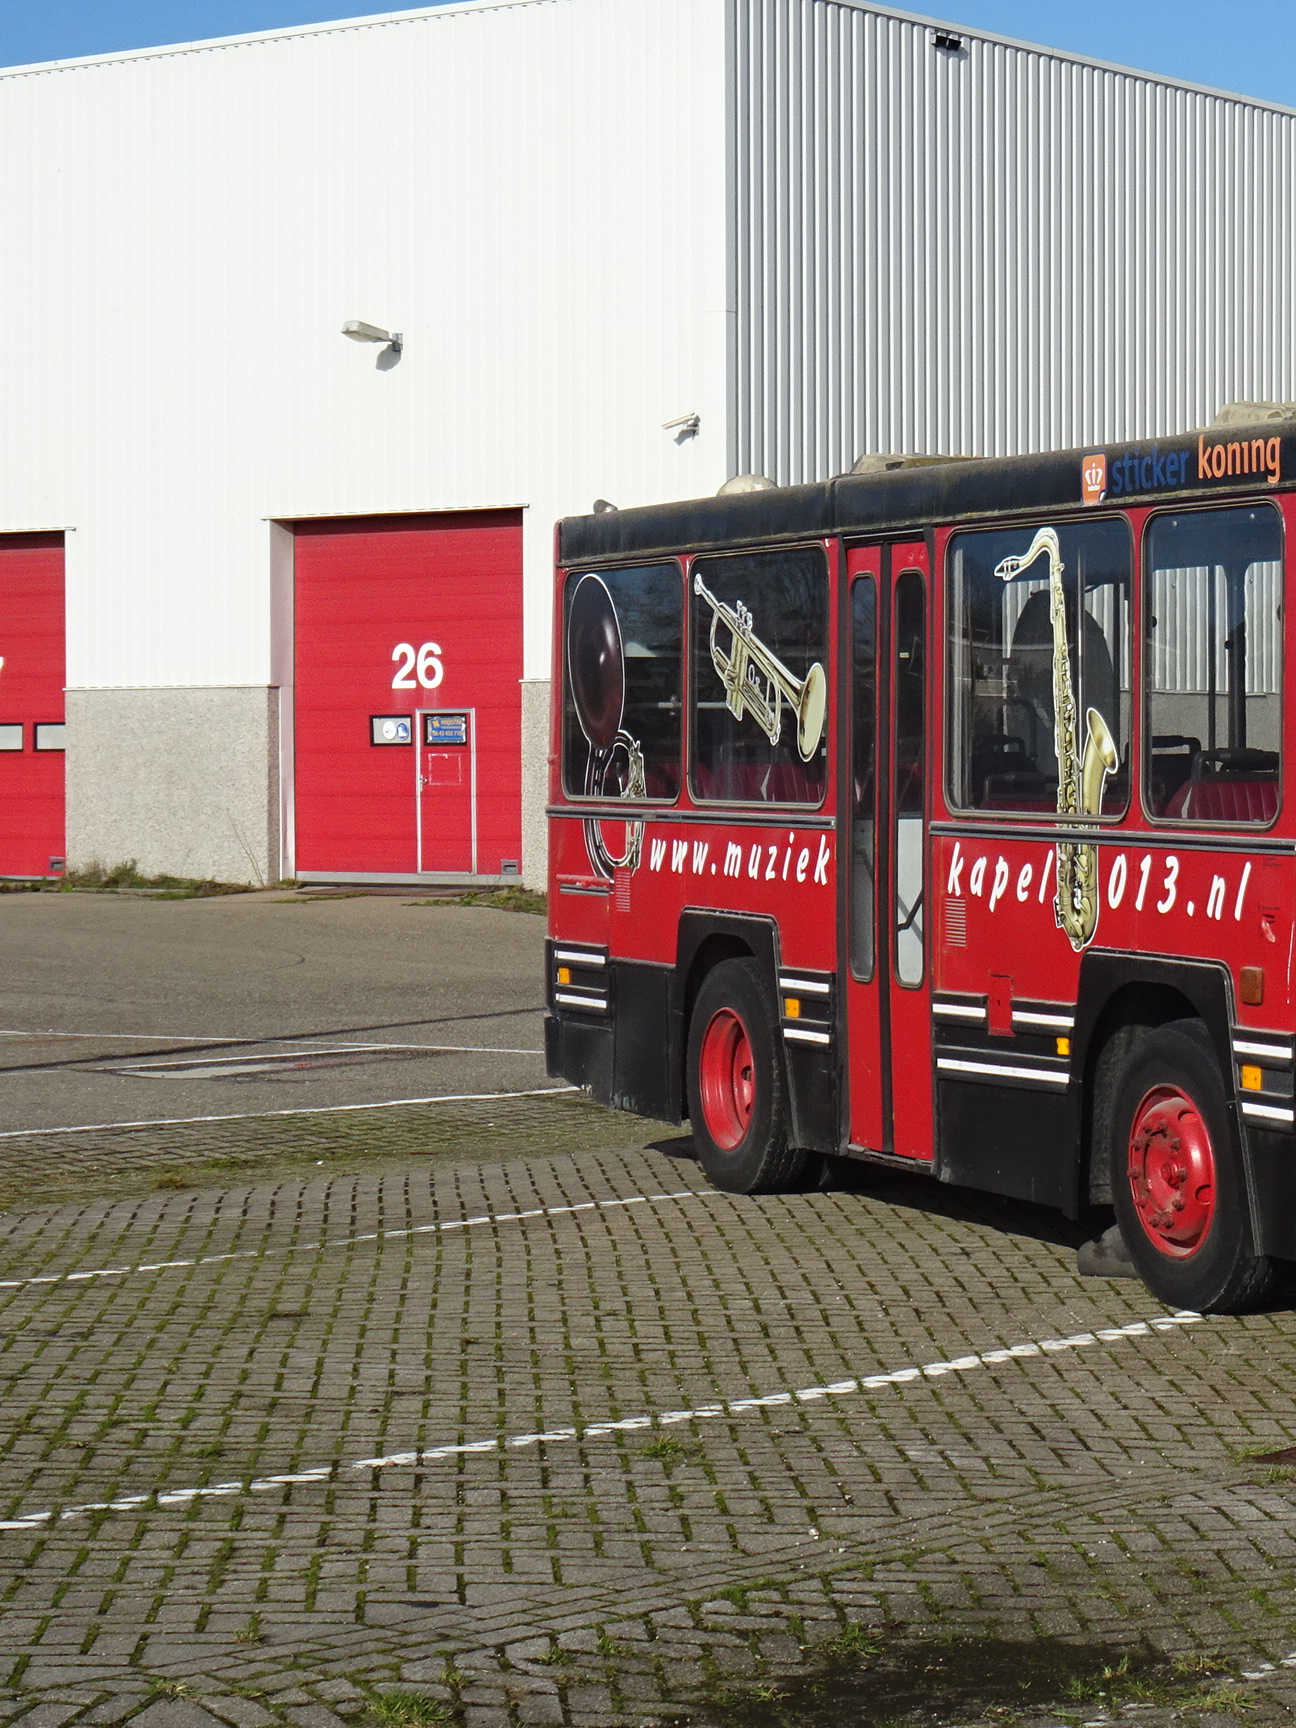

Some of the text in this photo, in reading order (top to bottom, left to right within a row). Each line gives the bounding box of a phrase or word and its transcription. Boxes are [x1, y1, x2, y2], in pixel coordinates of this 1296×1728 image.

[1111, 434, 1281, 494] sticker koning
[391, 642, 444, 689] 26
[650, 831, 1251, 921] www.muziek kapel 013.nl
